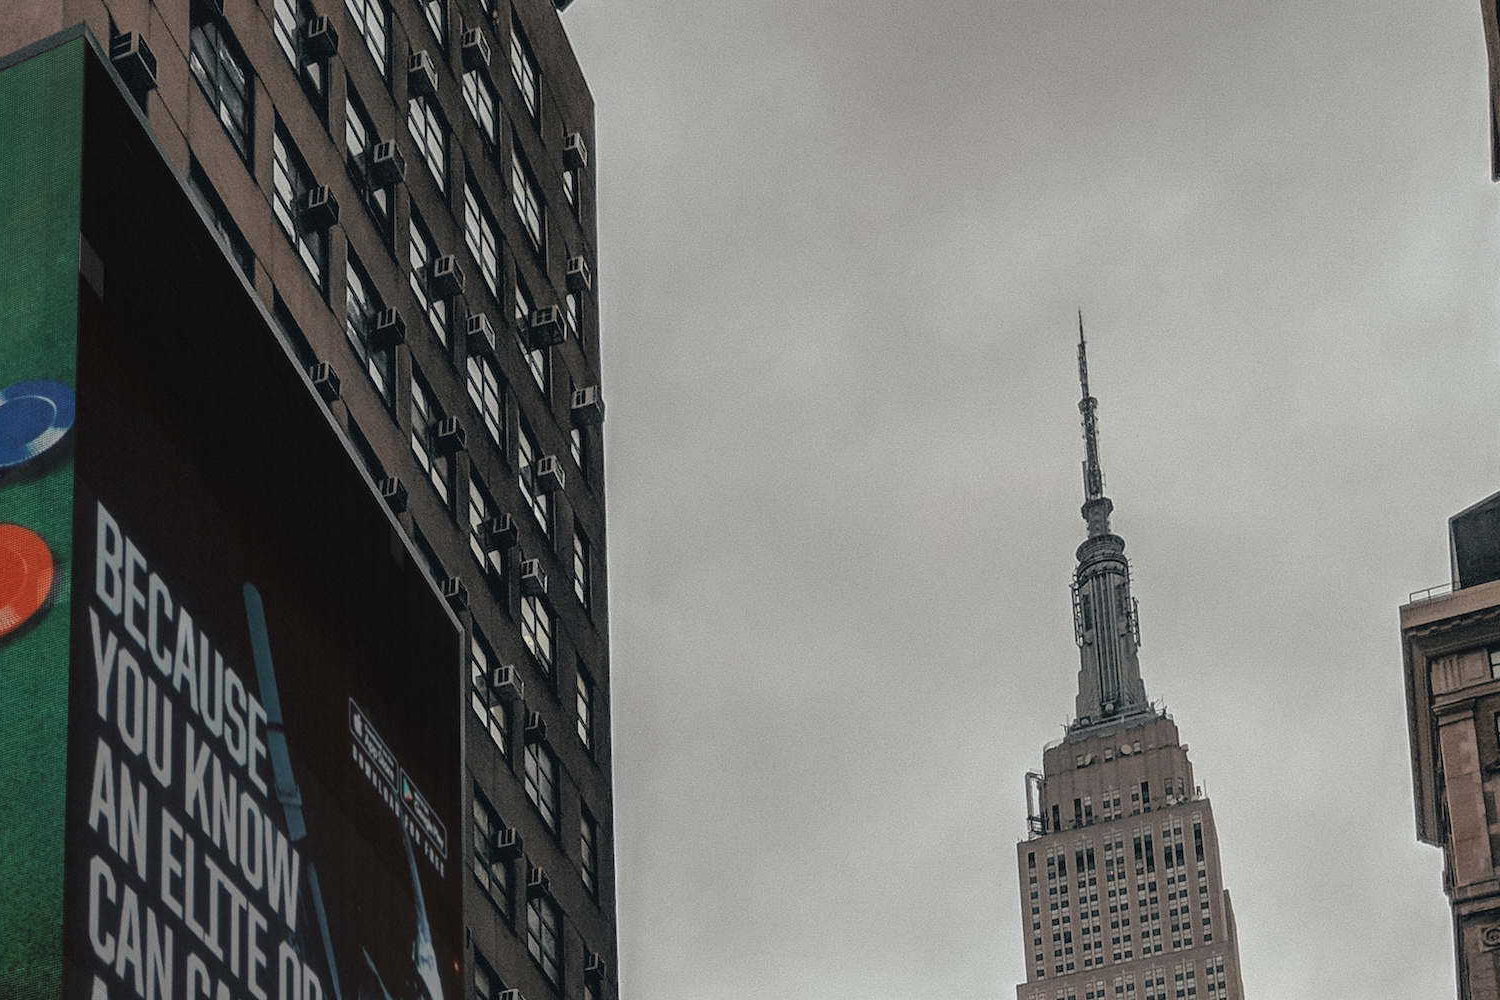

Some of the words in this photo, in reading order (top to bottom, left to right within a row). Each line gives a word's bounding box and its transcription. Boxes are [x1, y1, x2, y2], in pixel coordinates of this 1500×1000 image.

[89, 605, 173, 789] YOU
[185, 720, 300, 932] KNOW
[96, 499, 268, 798] BECAUSE
[89, 736, 147, 883] AN
